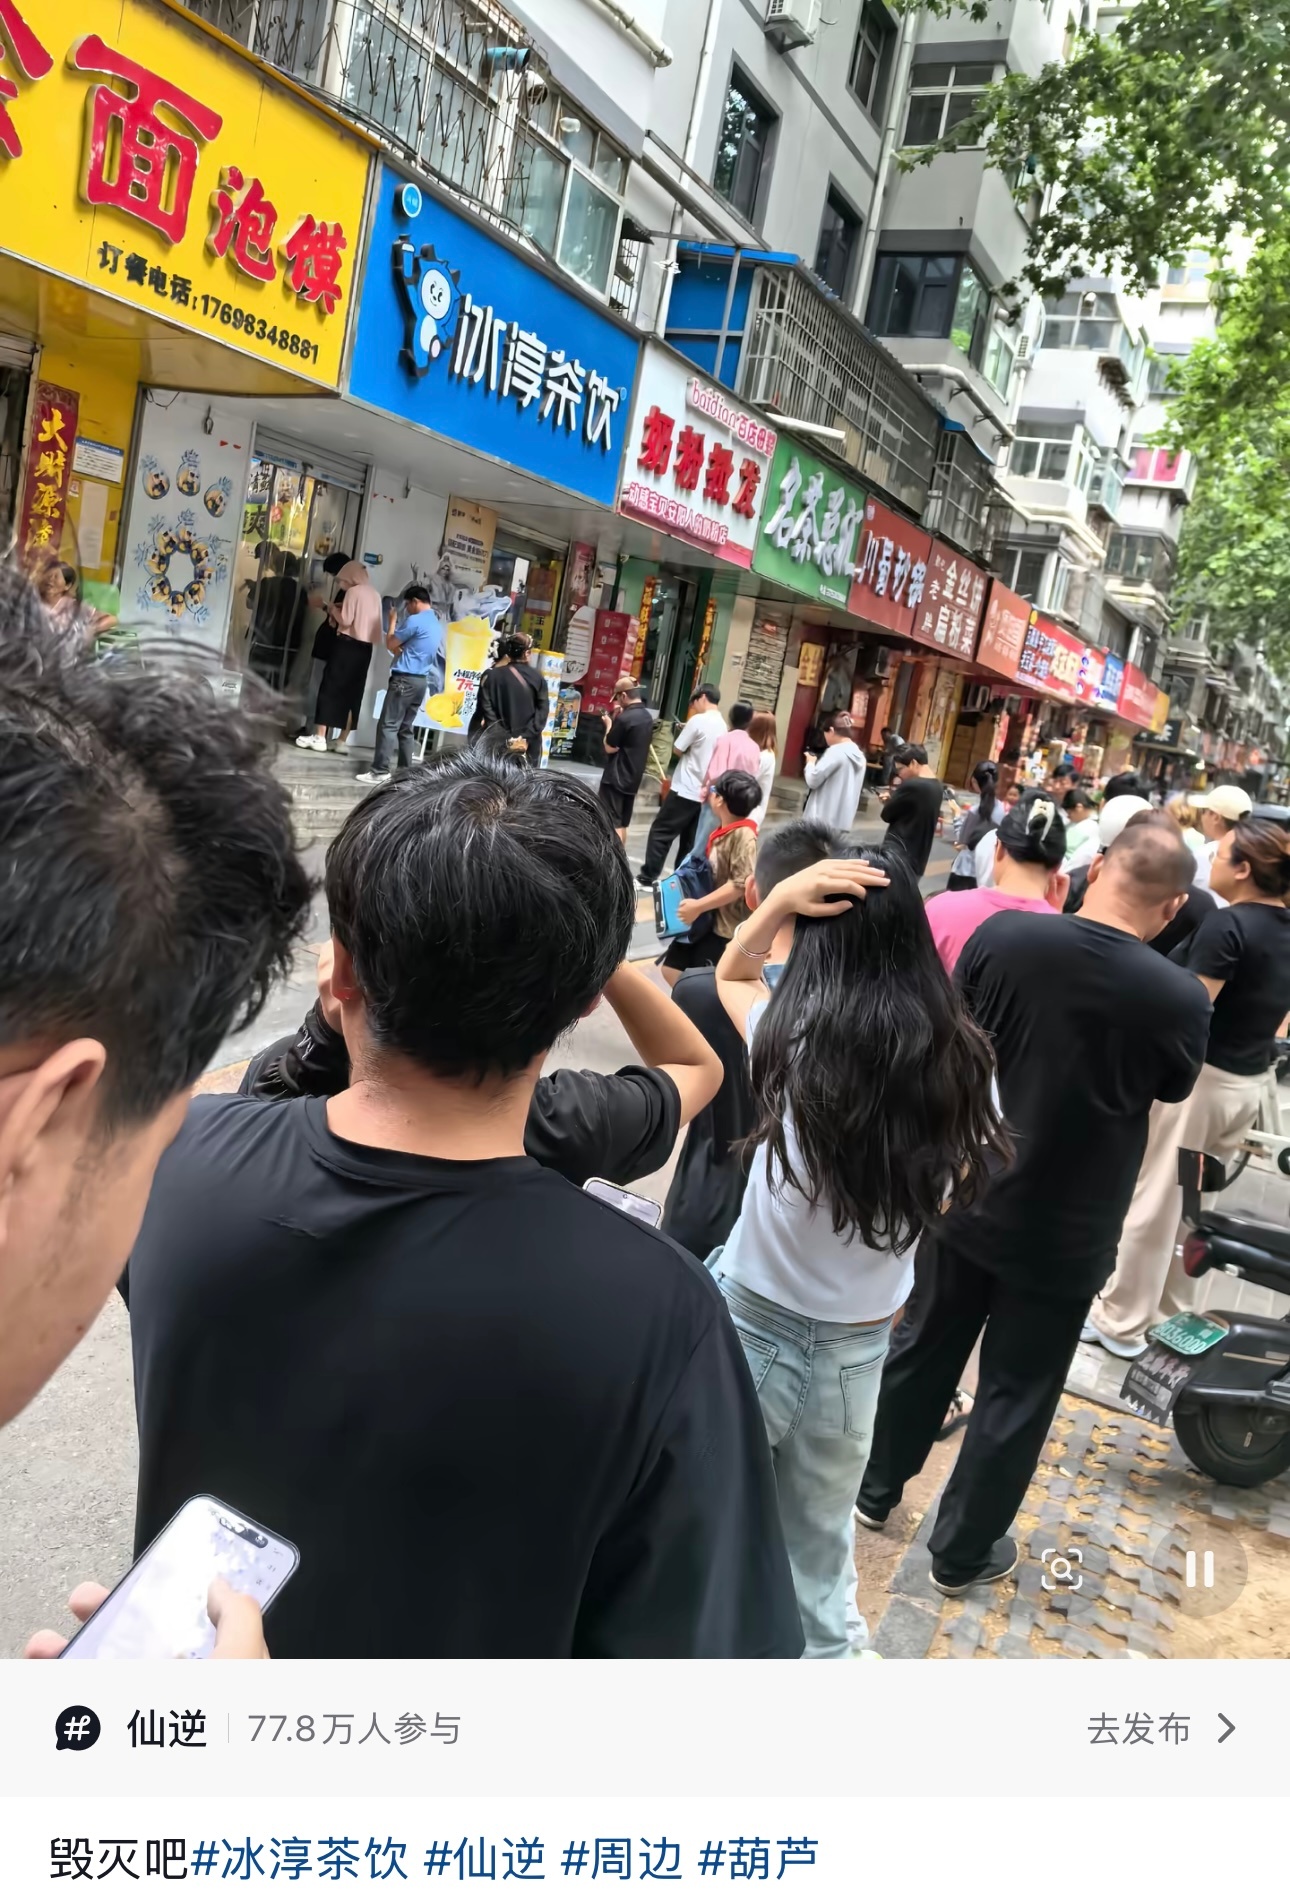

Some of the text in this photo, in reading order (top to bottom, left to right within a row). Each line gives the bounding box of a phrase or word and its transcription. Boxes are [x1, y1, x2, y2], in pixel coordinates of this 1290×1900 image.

[454, 292, 619, 451] 冰淳茶饮
[637, 405, 761, 519] 奶粉批发
